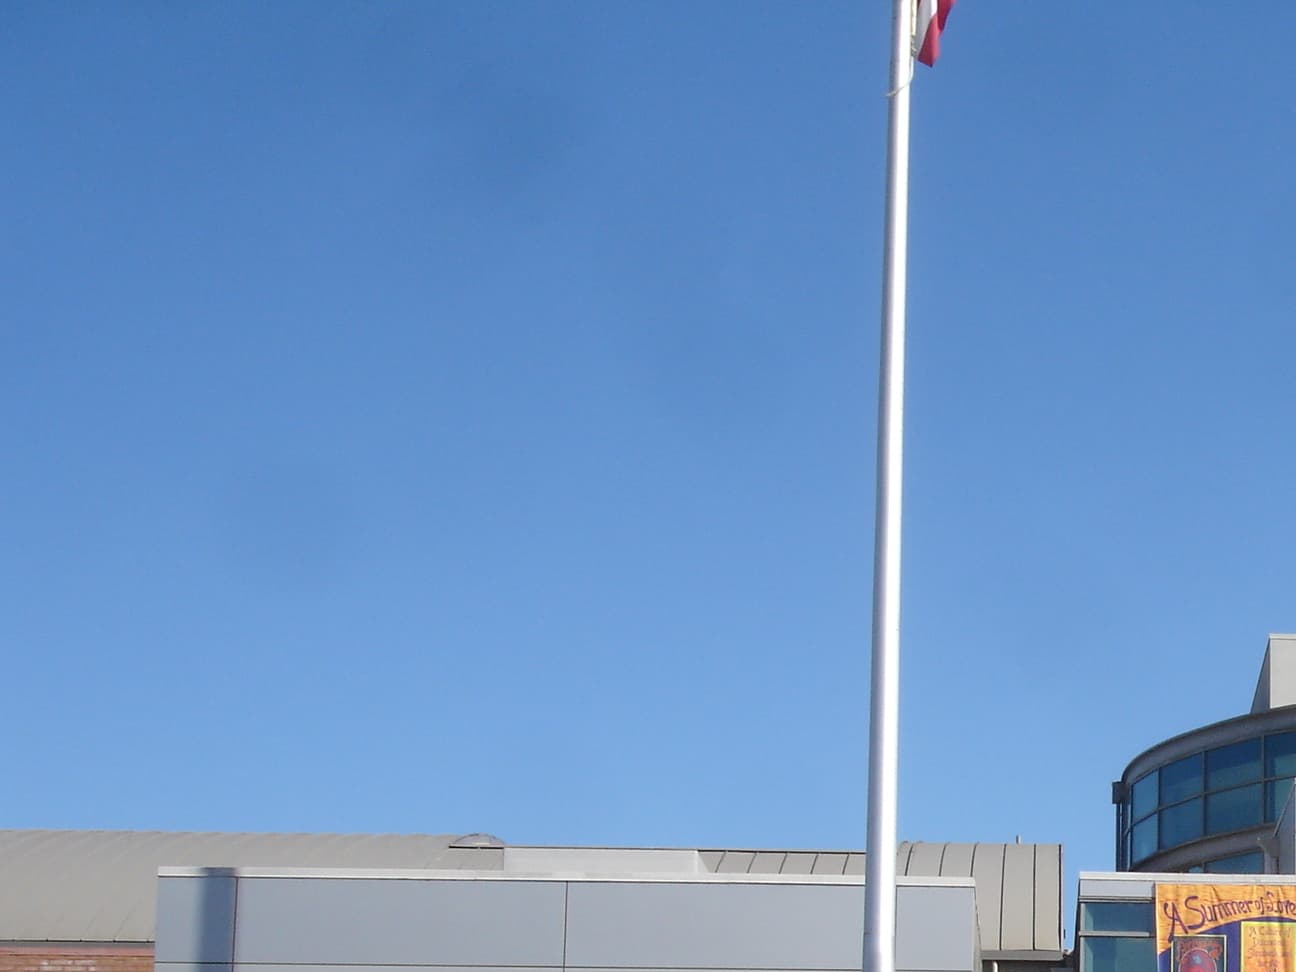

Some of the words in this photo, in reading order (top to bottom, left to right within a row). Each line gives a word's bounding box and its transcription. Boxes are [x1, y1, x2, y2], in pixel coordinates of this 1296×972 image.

[1163, 902, 1188, 943] A
[1184, 895, 1253, 930] Summer
[1254, 897, 1265, 915] of
[1265, 891, 1296, 916] Love
